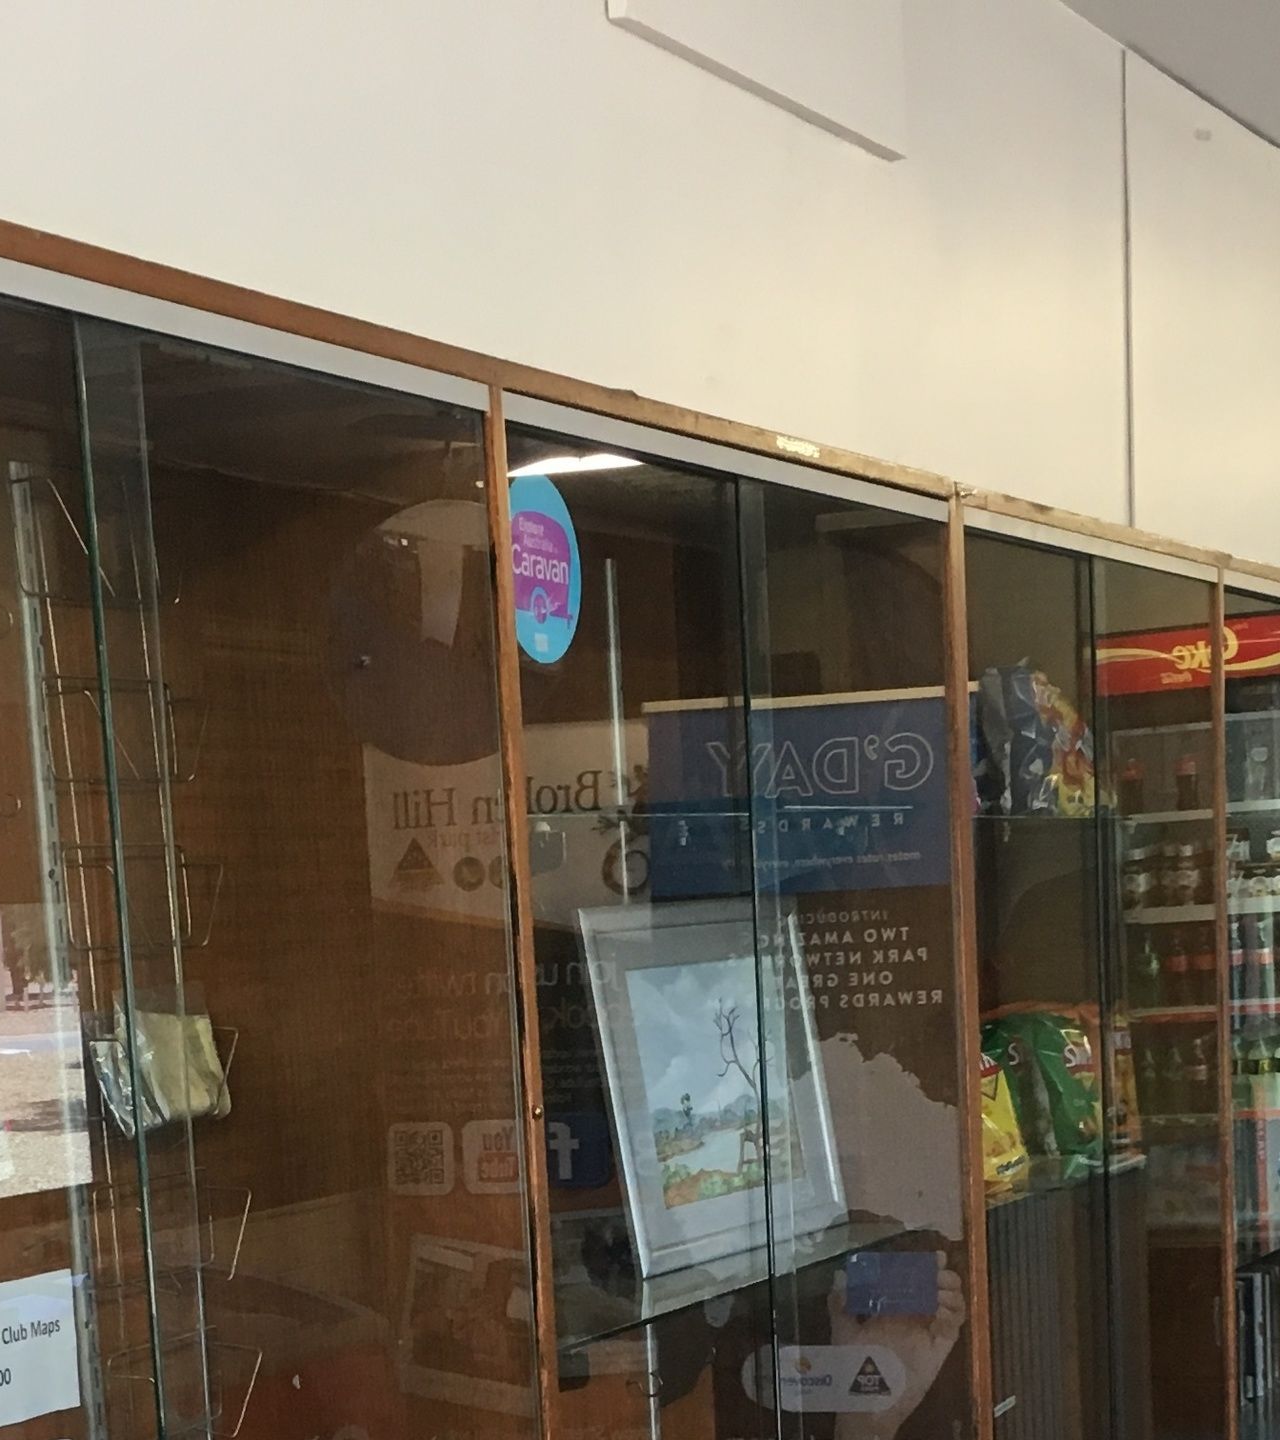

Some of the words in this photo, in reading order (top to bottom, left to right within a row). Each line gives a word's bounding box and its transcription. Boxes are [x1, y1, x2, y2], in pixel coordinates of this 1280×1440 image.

[512, 543, 569, 585] Caravan
[1, 1323, 28, 1345] Club
[30, 1318, 61, 1339] Maps
